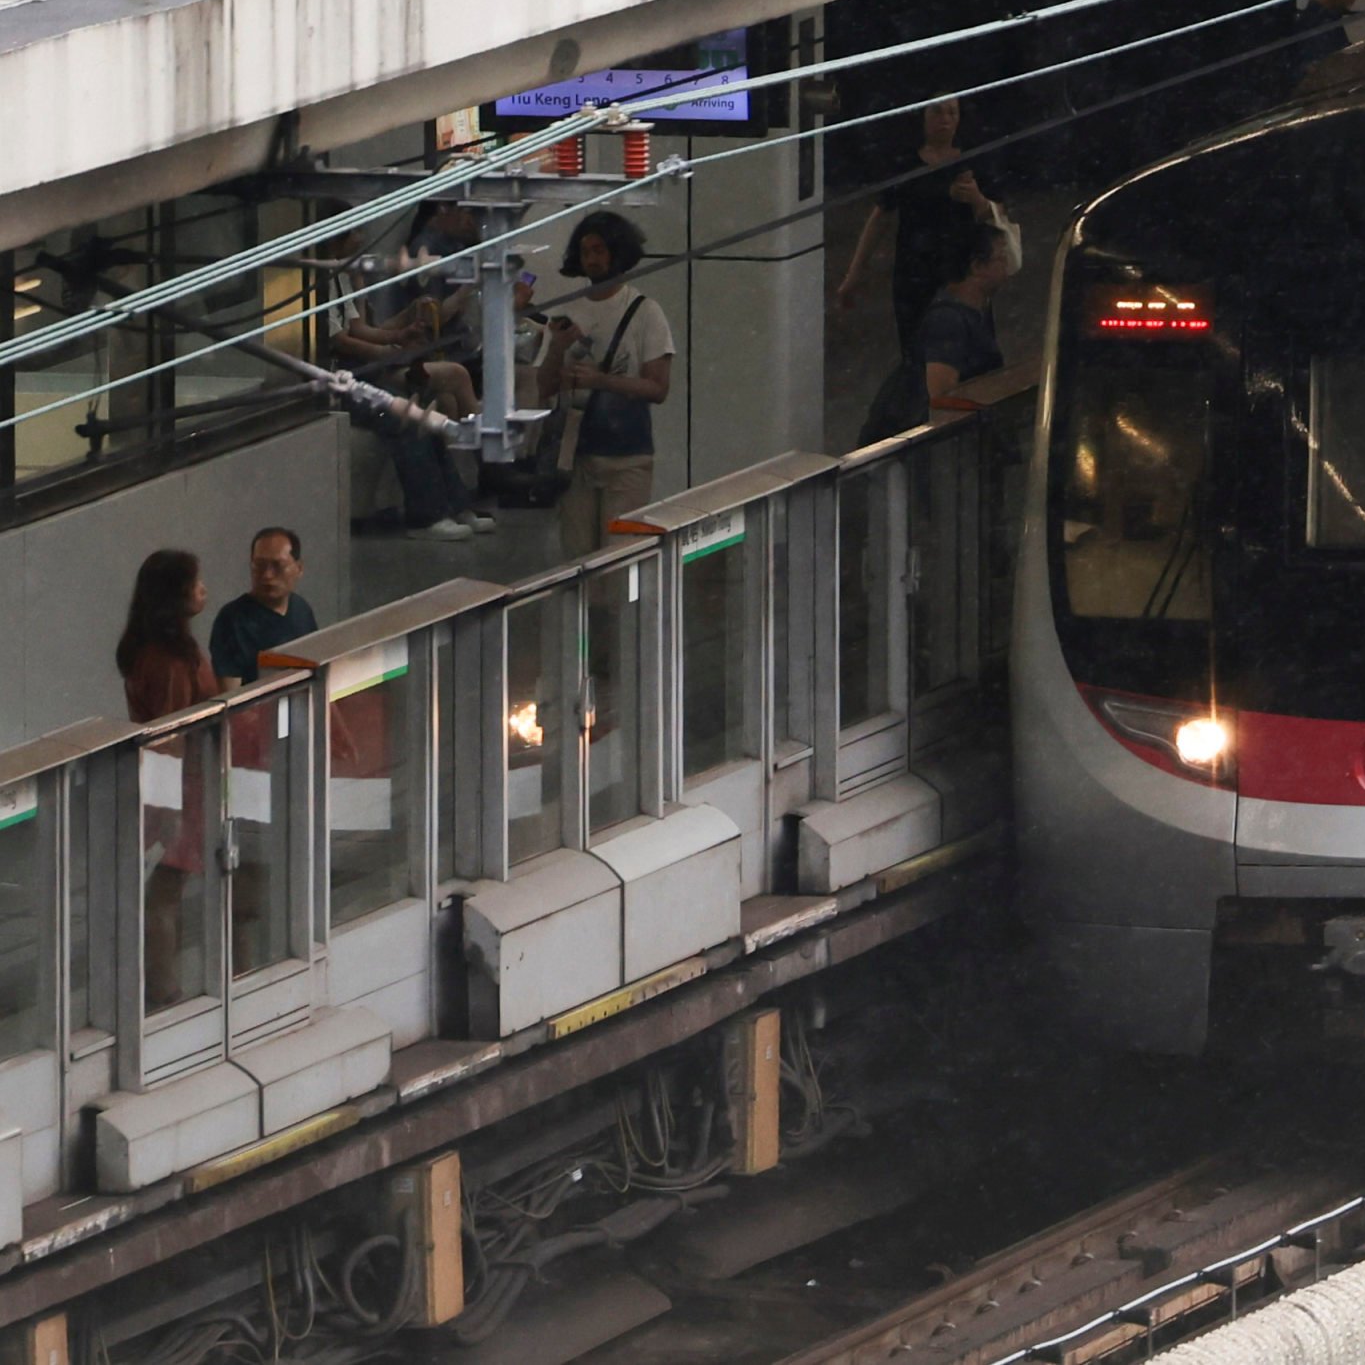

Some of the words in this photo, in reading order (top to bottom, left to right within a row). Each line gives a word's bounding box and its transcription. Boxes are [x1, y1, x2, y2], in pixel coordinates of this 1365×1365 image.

[605, 72, 614, 83] 4
[635, 73, 643, 84] 5
[664, 74, 673, 84] 6
[721, 75, 729, 85] 8
[535, 93, 571, 109] Keng
